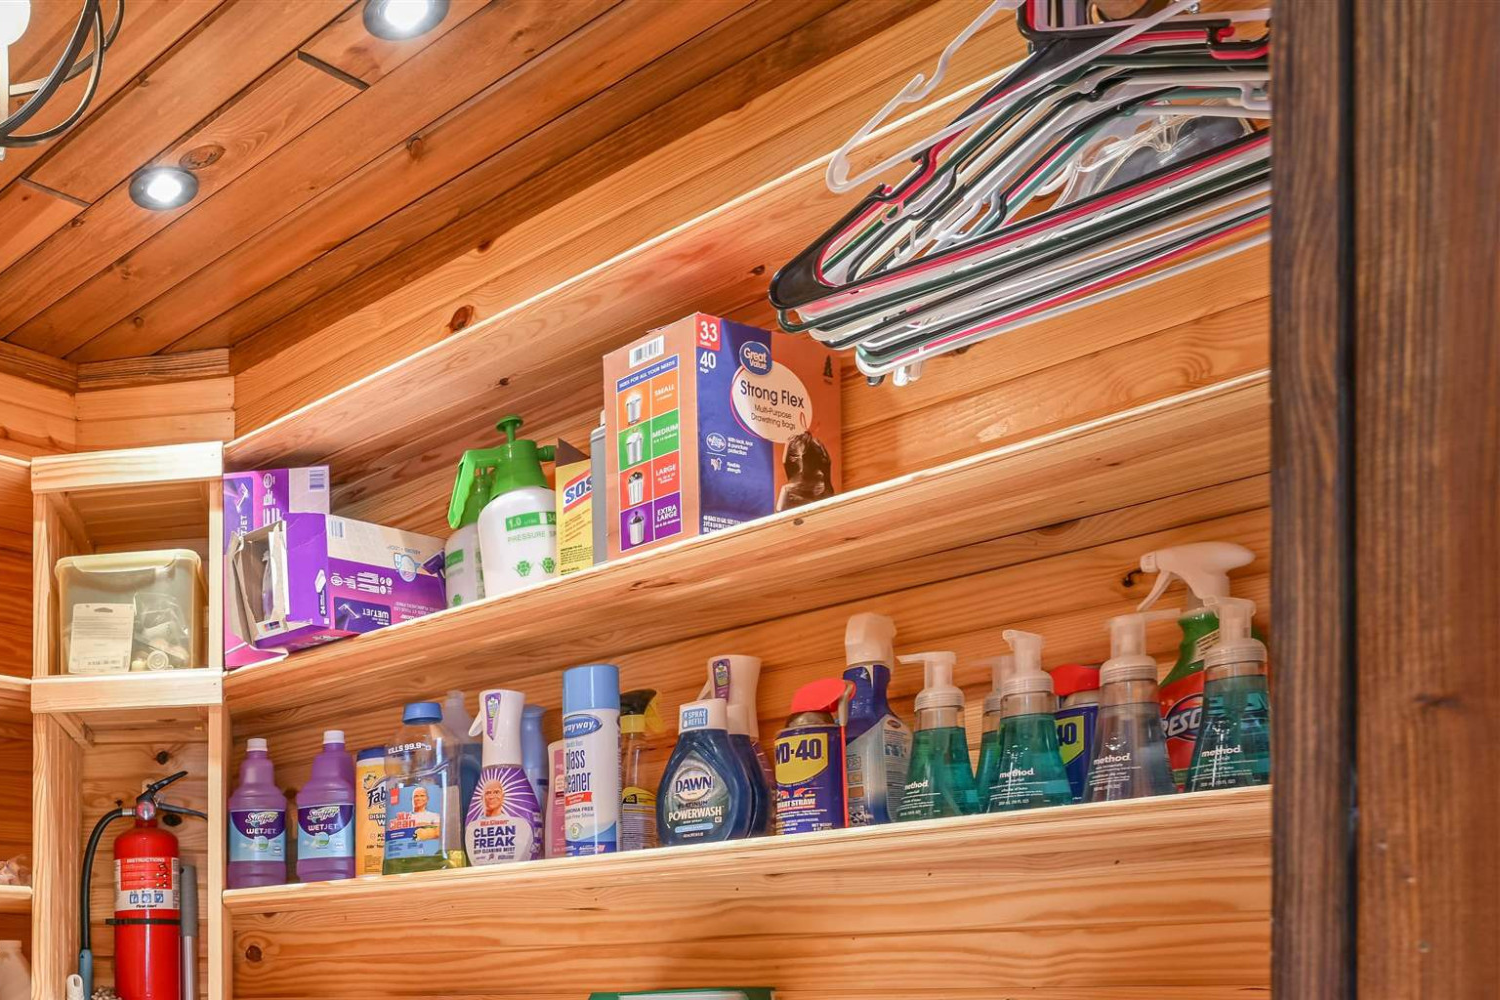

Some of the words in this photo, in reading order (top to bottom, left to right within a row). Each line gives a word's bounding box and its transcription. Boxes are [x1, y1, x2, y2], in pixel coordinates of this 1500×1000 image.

[700, 321, 718, 342] 33
[700, 351, 716, 369] 40
[743, 348, 767, 363] Great
[749, 359, 767, 370] Value
[655, 384, 675, 396] SMALL
[740, 380, 778, 406] Strong
[782, 390, 805, 409] Flex
[754, 404, 792, 420] Multi-Purpose
[751, 412, 781, 428] Drawstring
[782, 418, 796, 430] Bags
[652, 424, 678, 438] MEDIUM
[656, 464, 676, 475] LARGE
[657, 505, 676, 516] EXTRA
[657, 511, 677, 522] LARGE
[509, 518, 521, 529] 1.0
[508, 531, 546, 542] PRESSURE
[362, 608, 390, 619] WETJET
[688, 710, 706, 718] SPRAY
[688, 717, 706, 726] REFILL
[1202, 745, 1242, 757] method
[1093, 753, 1131, 765] method
[1000, 768, 1034, 778] method
[675, 776, 712, 793] DAWN
[668, 806, 722, 822] POWERWASH
[246, 827, 277, 835] WETJET
[308, 823, 338, 831] WETJET
[473, 825, 516, 837] CLEAN
[473, 836, 515, 849] FREAK
